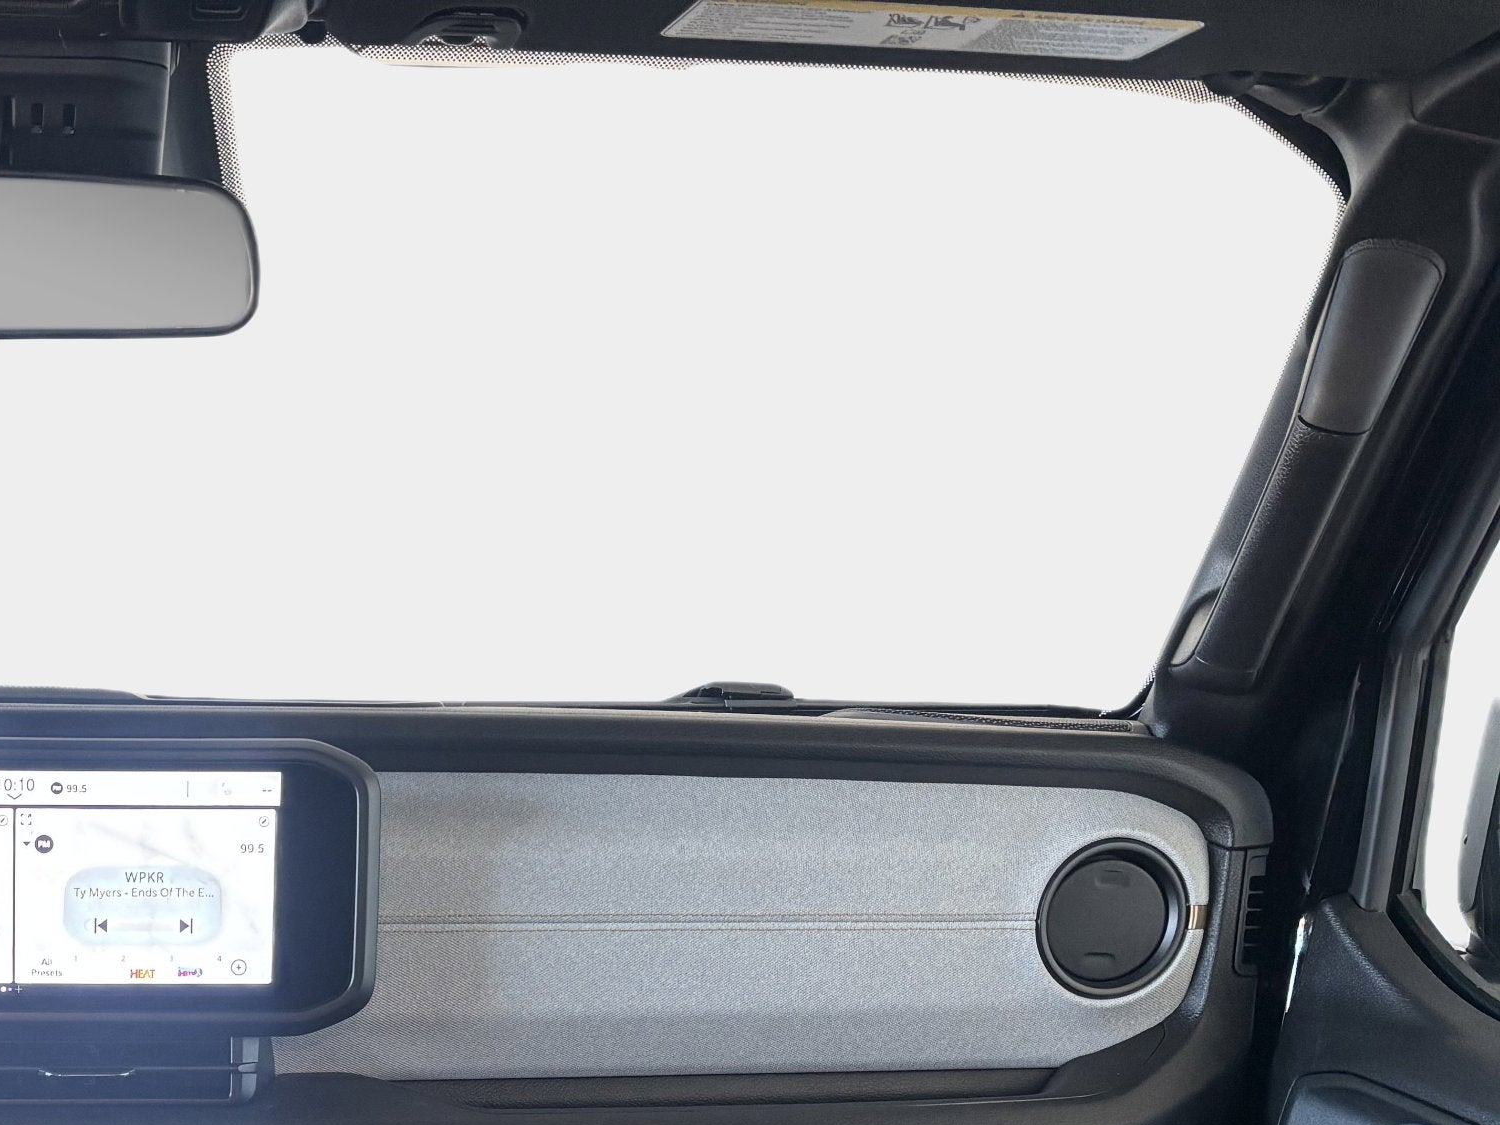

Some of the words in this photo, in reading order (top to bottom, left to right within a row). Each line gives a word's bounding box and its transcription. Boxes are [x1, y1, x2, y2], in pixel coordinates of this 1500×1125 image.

[66, 785, 87, 793] 99.5
[125, 871, 164, 883] WPKR
[73, 887, 86, 899] Ty
[89, 888, 122, 899] Myers
[132, 887, 158, 898] Ends
[160, 887, 173, 898] Of
[176, 888, 195, 898] The
[31, 968, 63, 977] Presets
[130, 969, 155, 979] HEAT
